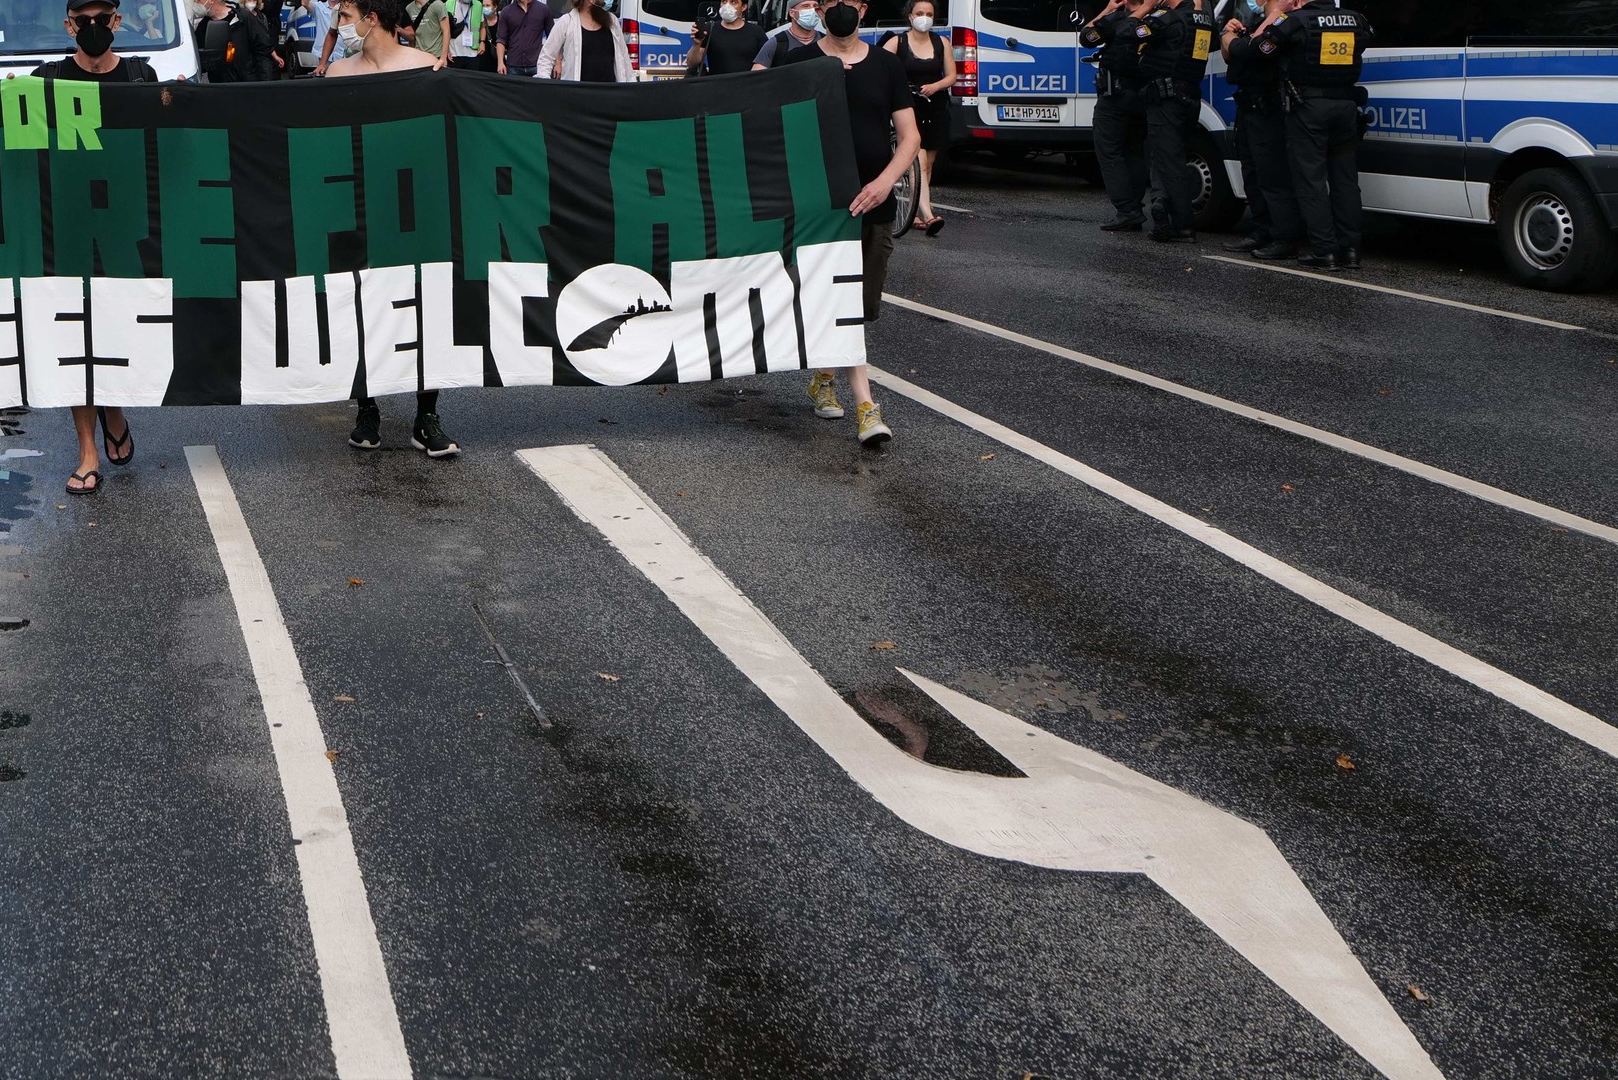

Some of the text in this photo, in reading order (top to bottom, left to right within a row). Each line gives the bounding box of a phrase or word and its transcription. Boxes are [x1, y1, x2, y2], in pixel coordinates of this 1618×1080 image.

[1318, 15, 1357, 27] POLIZEI
[1328, 41, 1348, 56] 38
[647, 53, 687, 66] POLIZ
[988, 74, 1067, 91] POLIZEI
[1004, 107, 1058, 119] WI HP 9114
[287, 113, 552, 296] FOR
[609, 98, 864, 282] ALL
[240, 240, 866, 406] WELCOME
